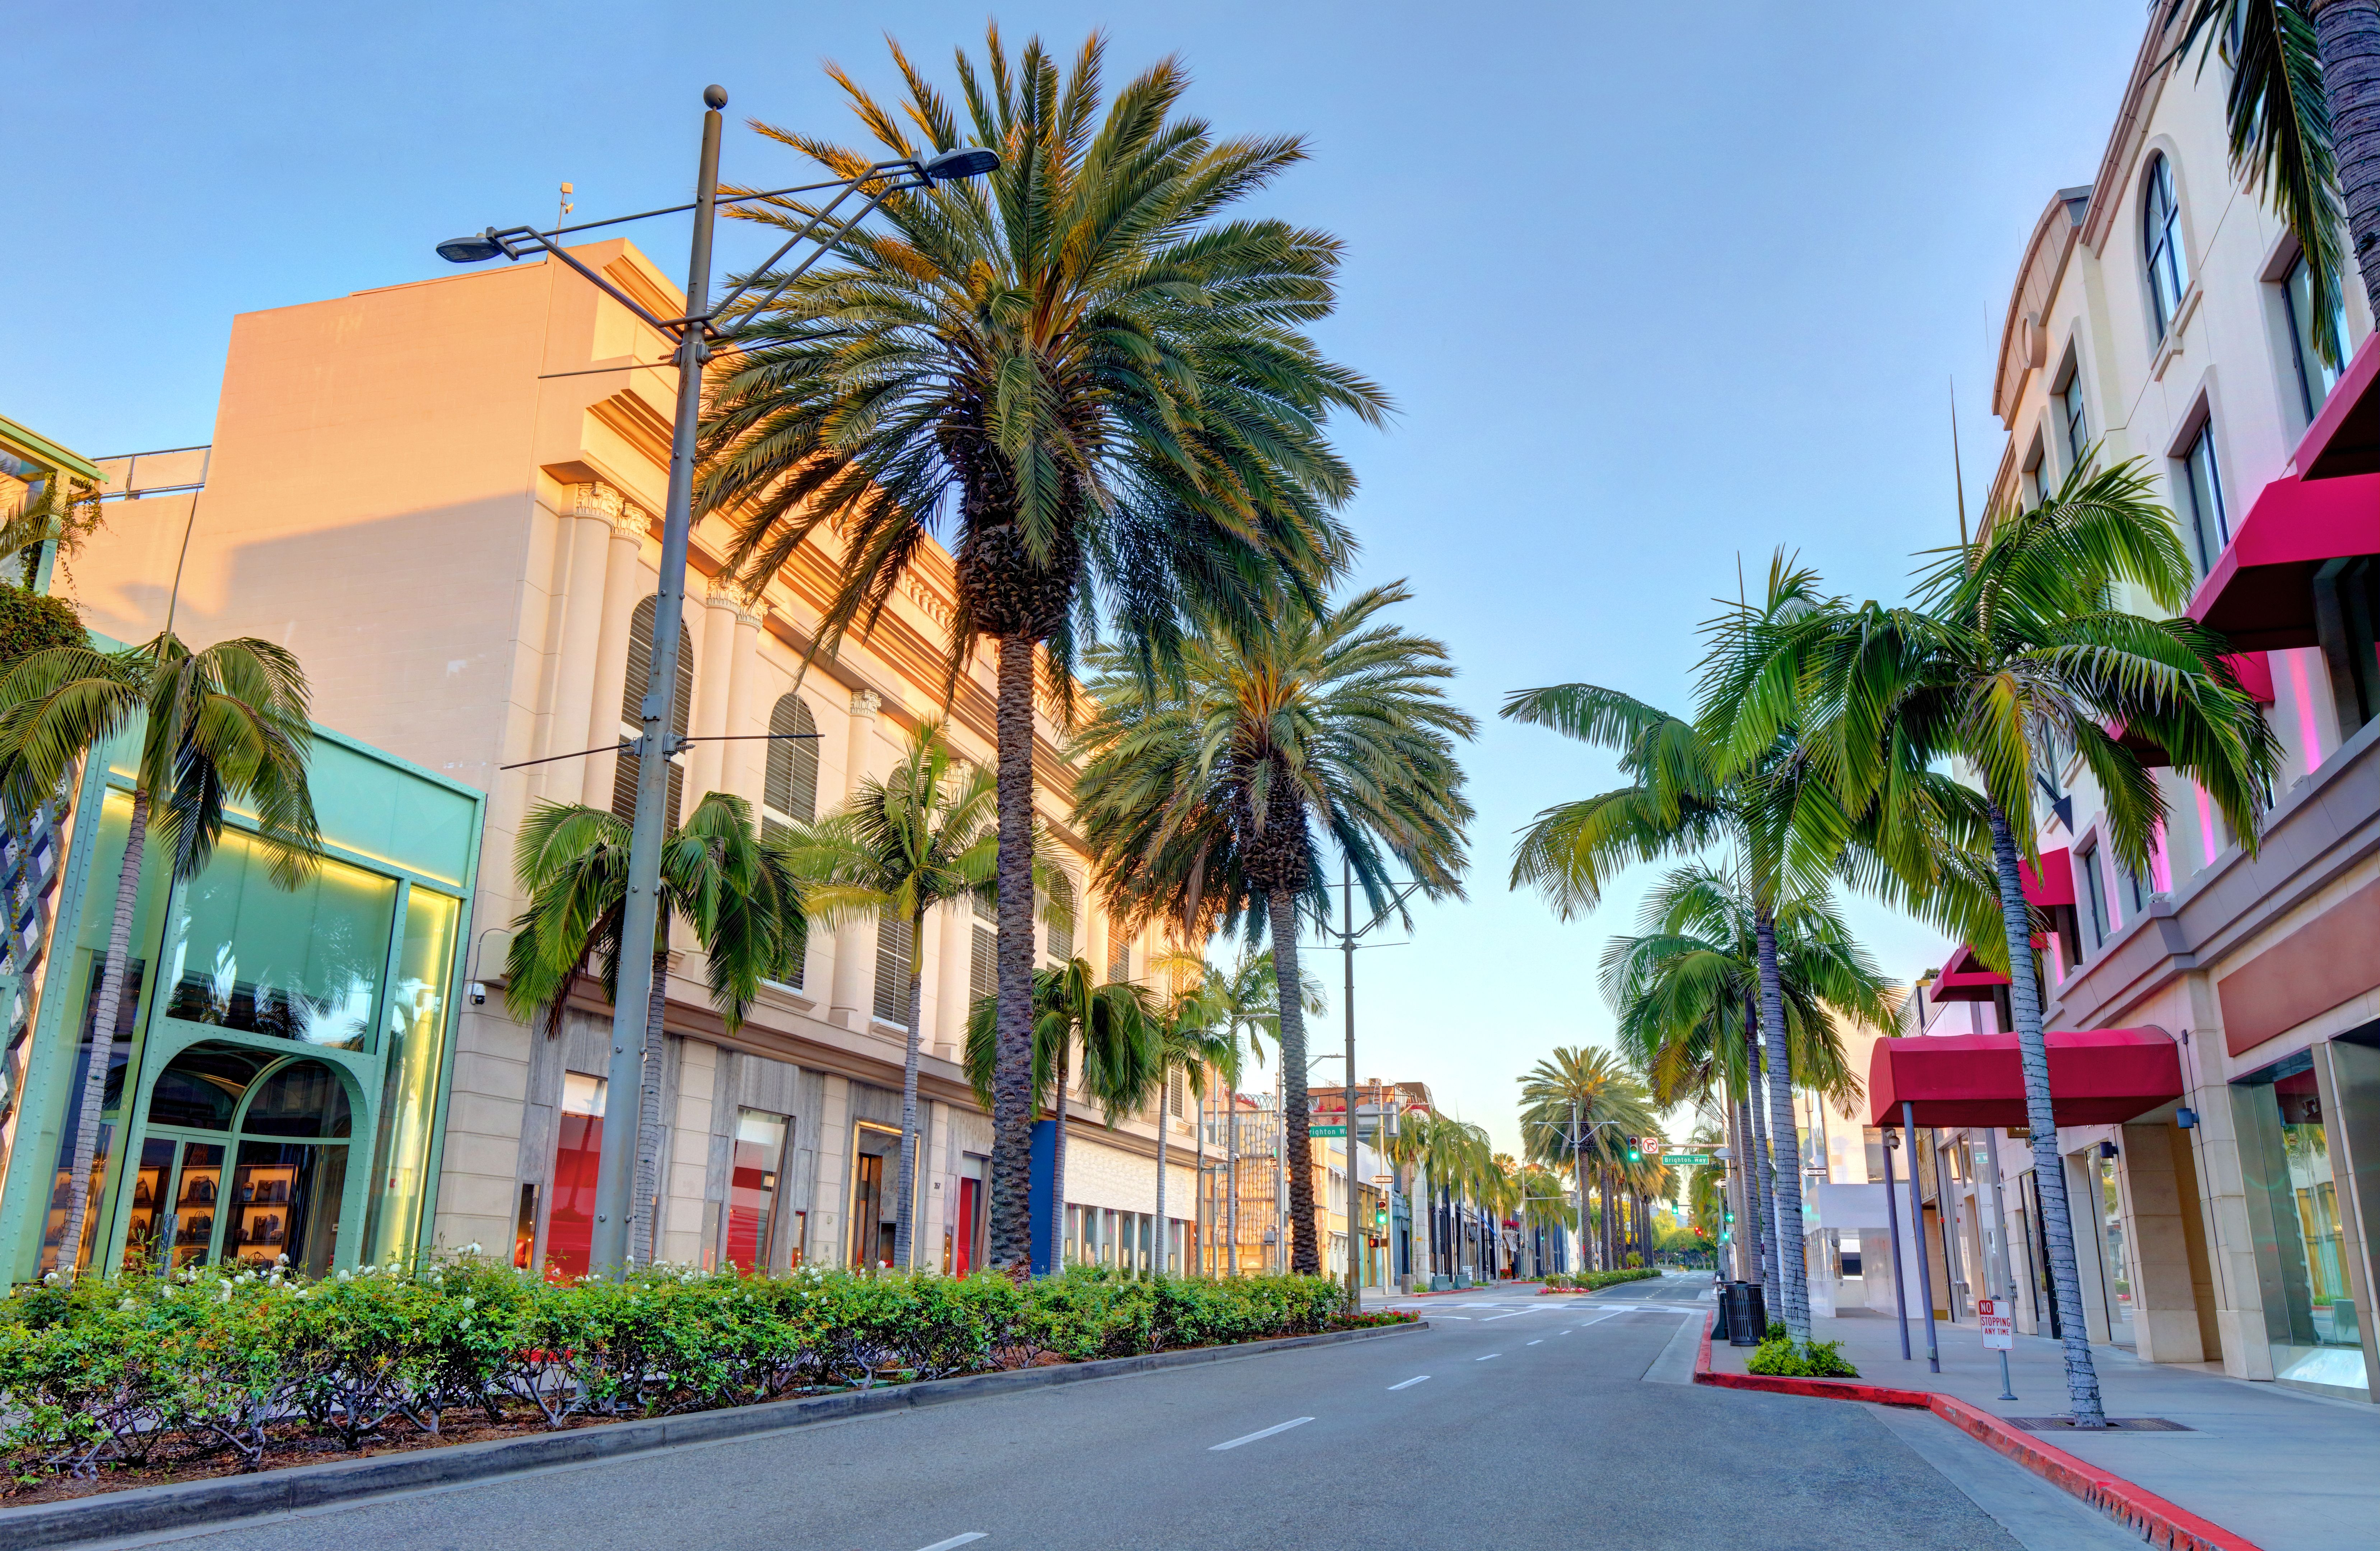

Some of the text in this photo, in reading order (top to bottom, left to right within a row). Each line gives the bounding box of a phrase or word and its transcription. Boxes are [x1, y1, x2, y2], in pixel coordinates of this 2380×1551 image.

[1309, 1128, 1335, 1137] righton
[1980, 1302, 1991, 1313] NO
[1981, 1317, 2011, 1327] STOPPING
